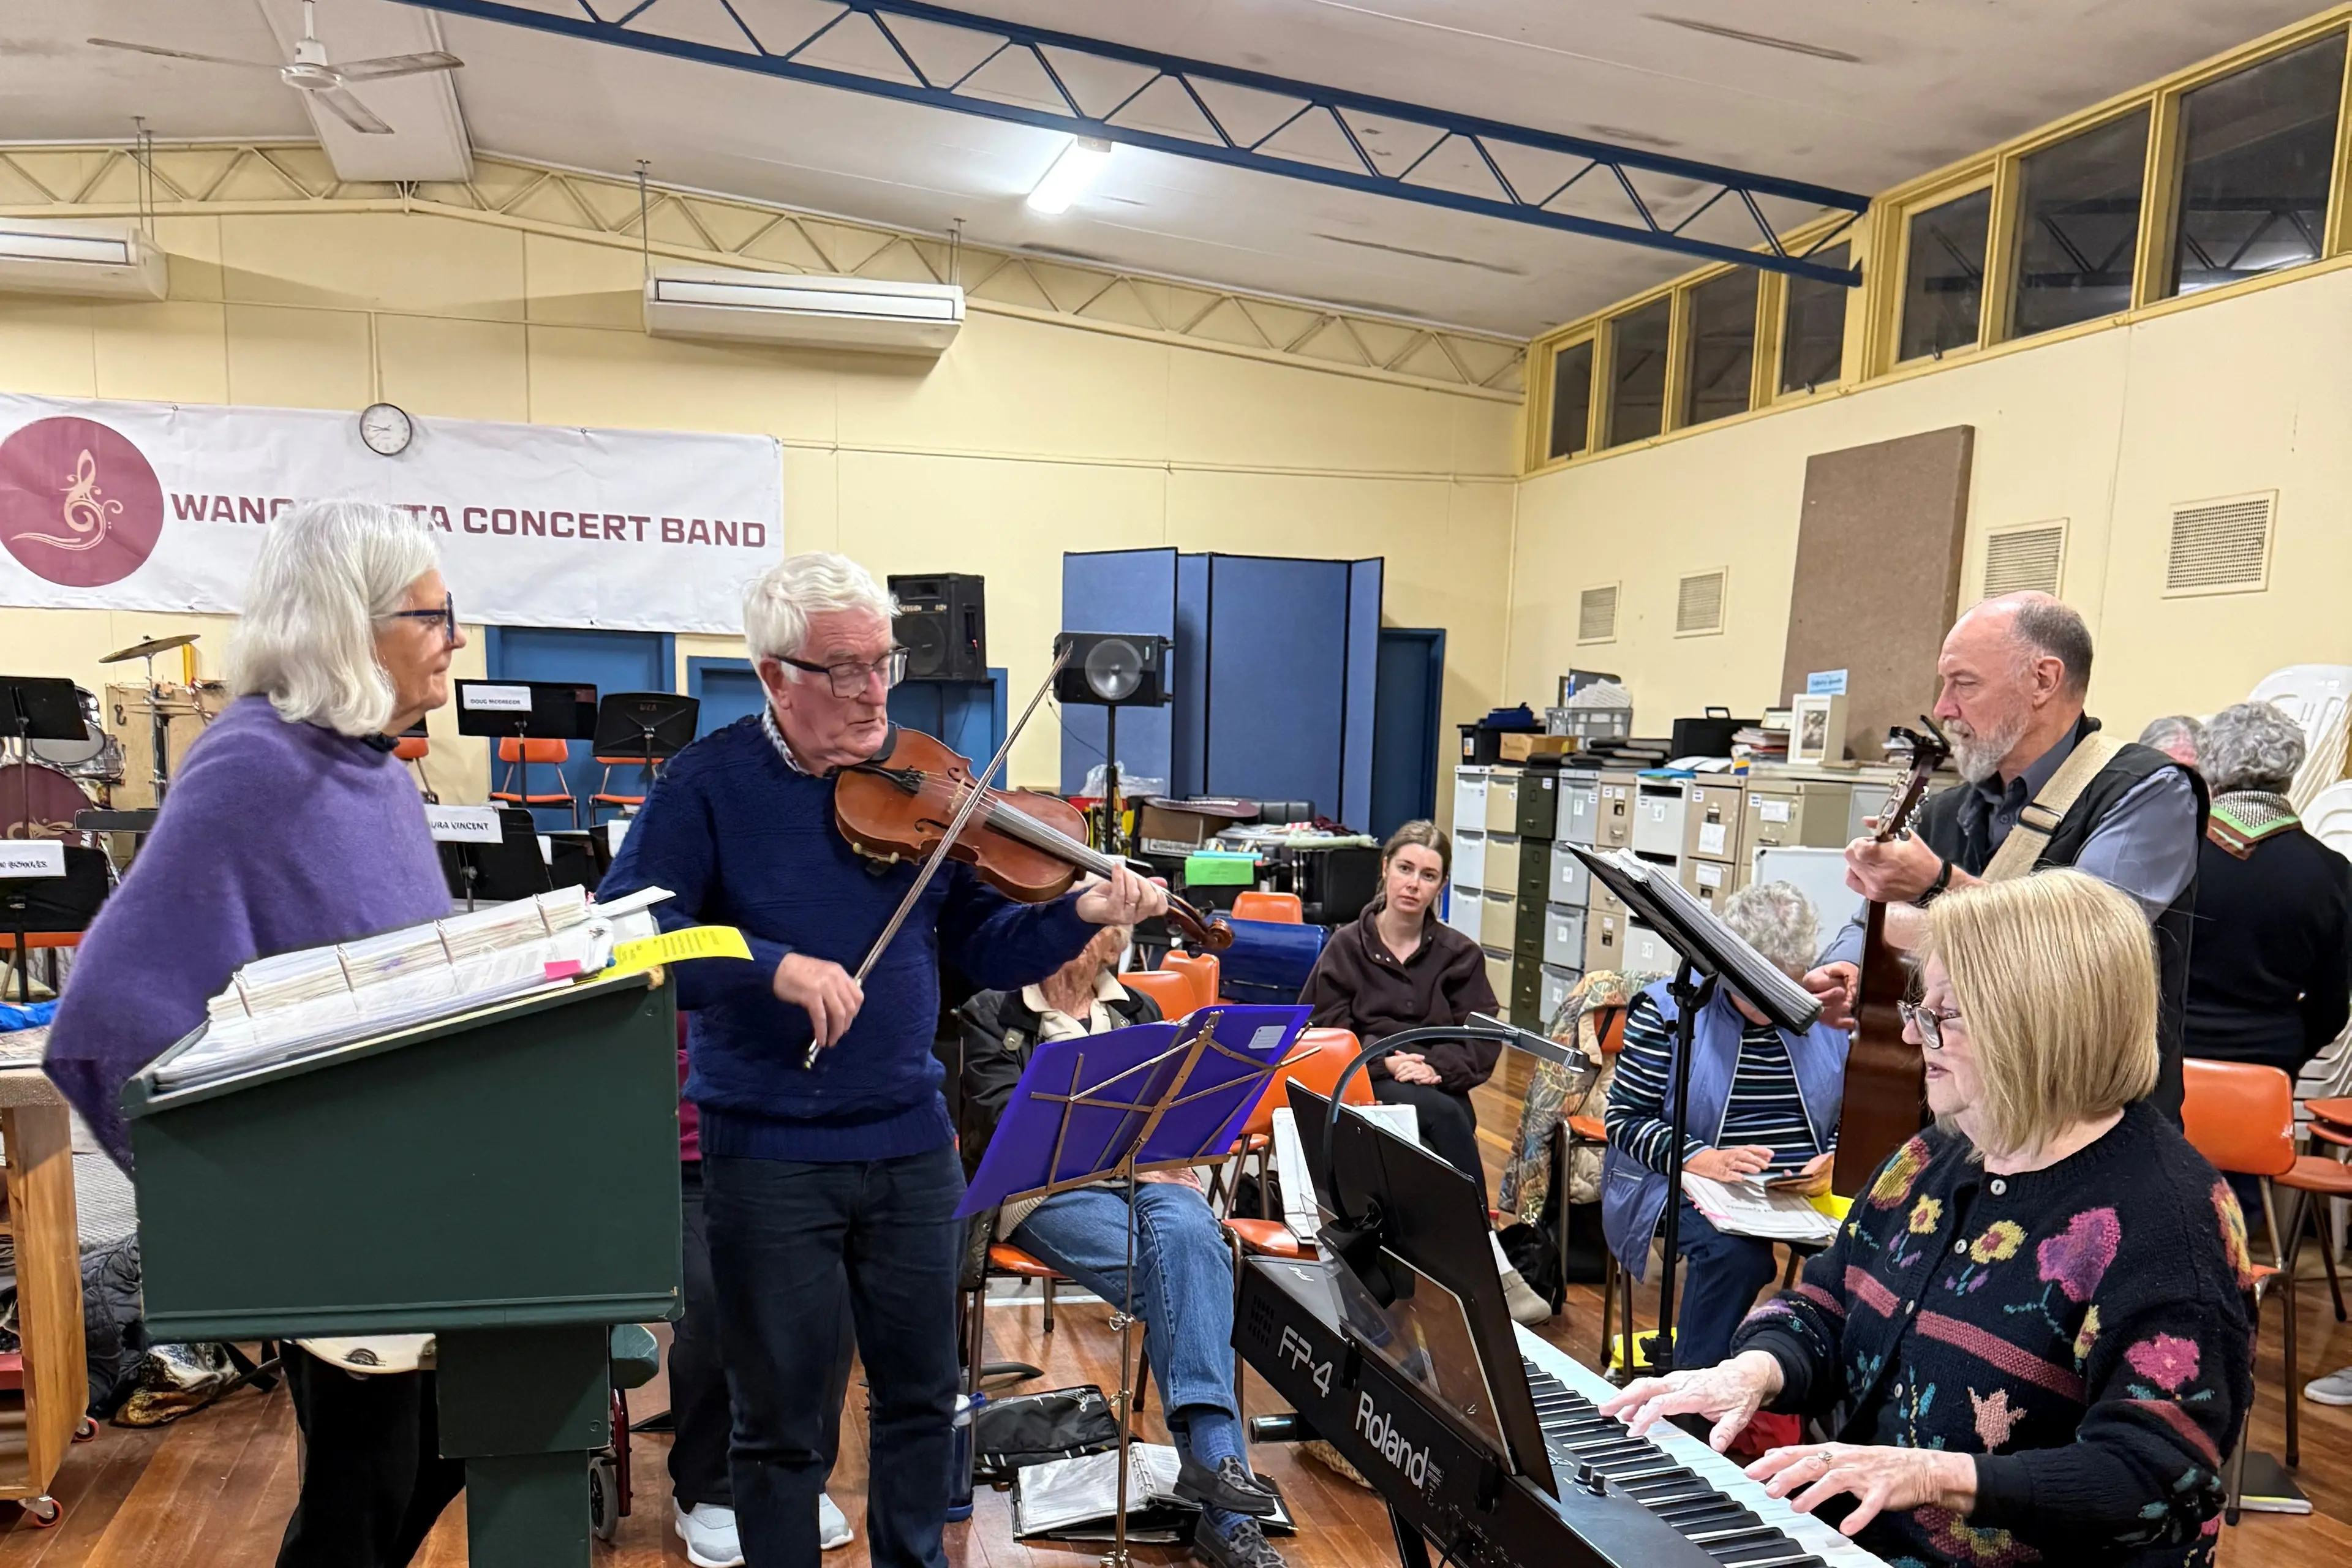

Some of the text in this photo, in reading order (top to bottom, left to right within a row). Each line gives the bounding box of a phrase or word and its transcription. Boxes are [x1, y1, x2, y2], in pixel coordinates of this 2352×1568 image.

[463, 507, 650, 541] CONCERT
[662, 518, 765, 547] BAND
[451, 821, 489, 831] VINCENT
[1278, 1325, 1333, 1398] FP-4
[1355, 1390, 1429, 1489] Roland
